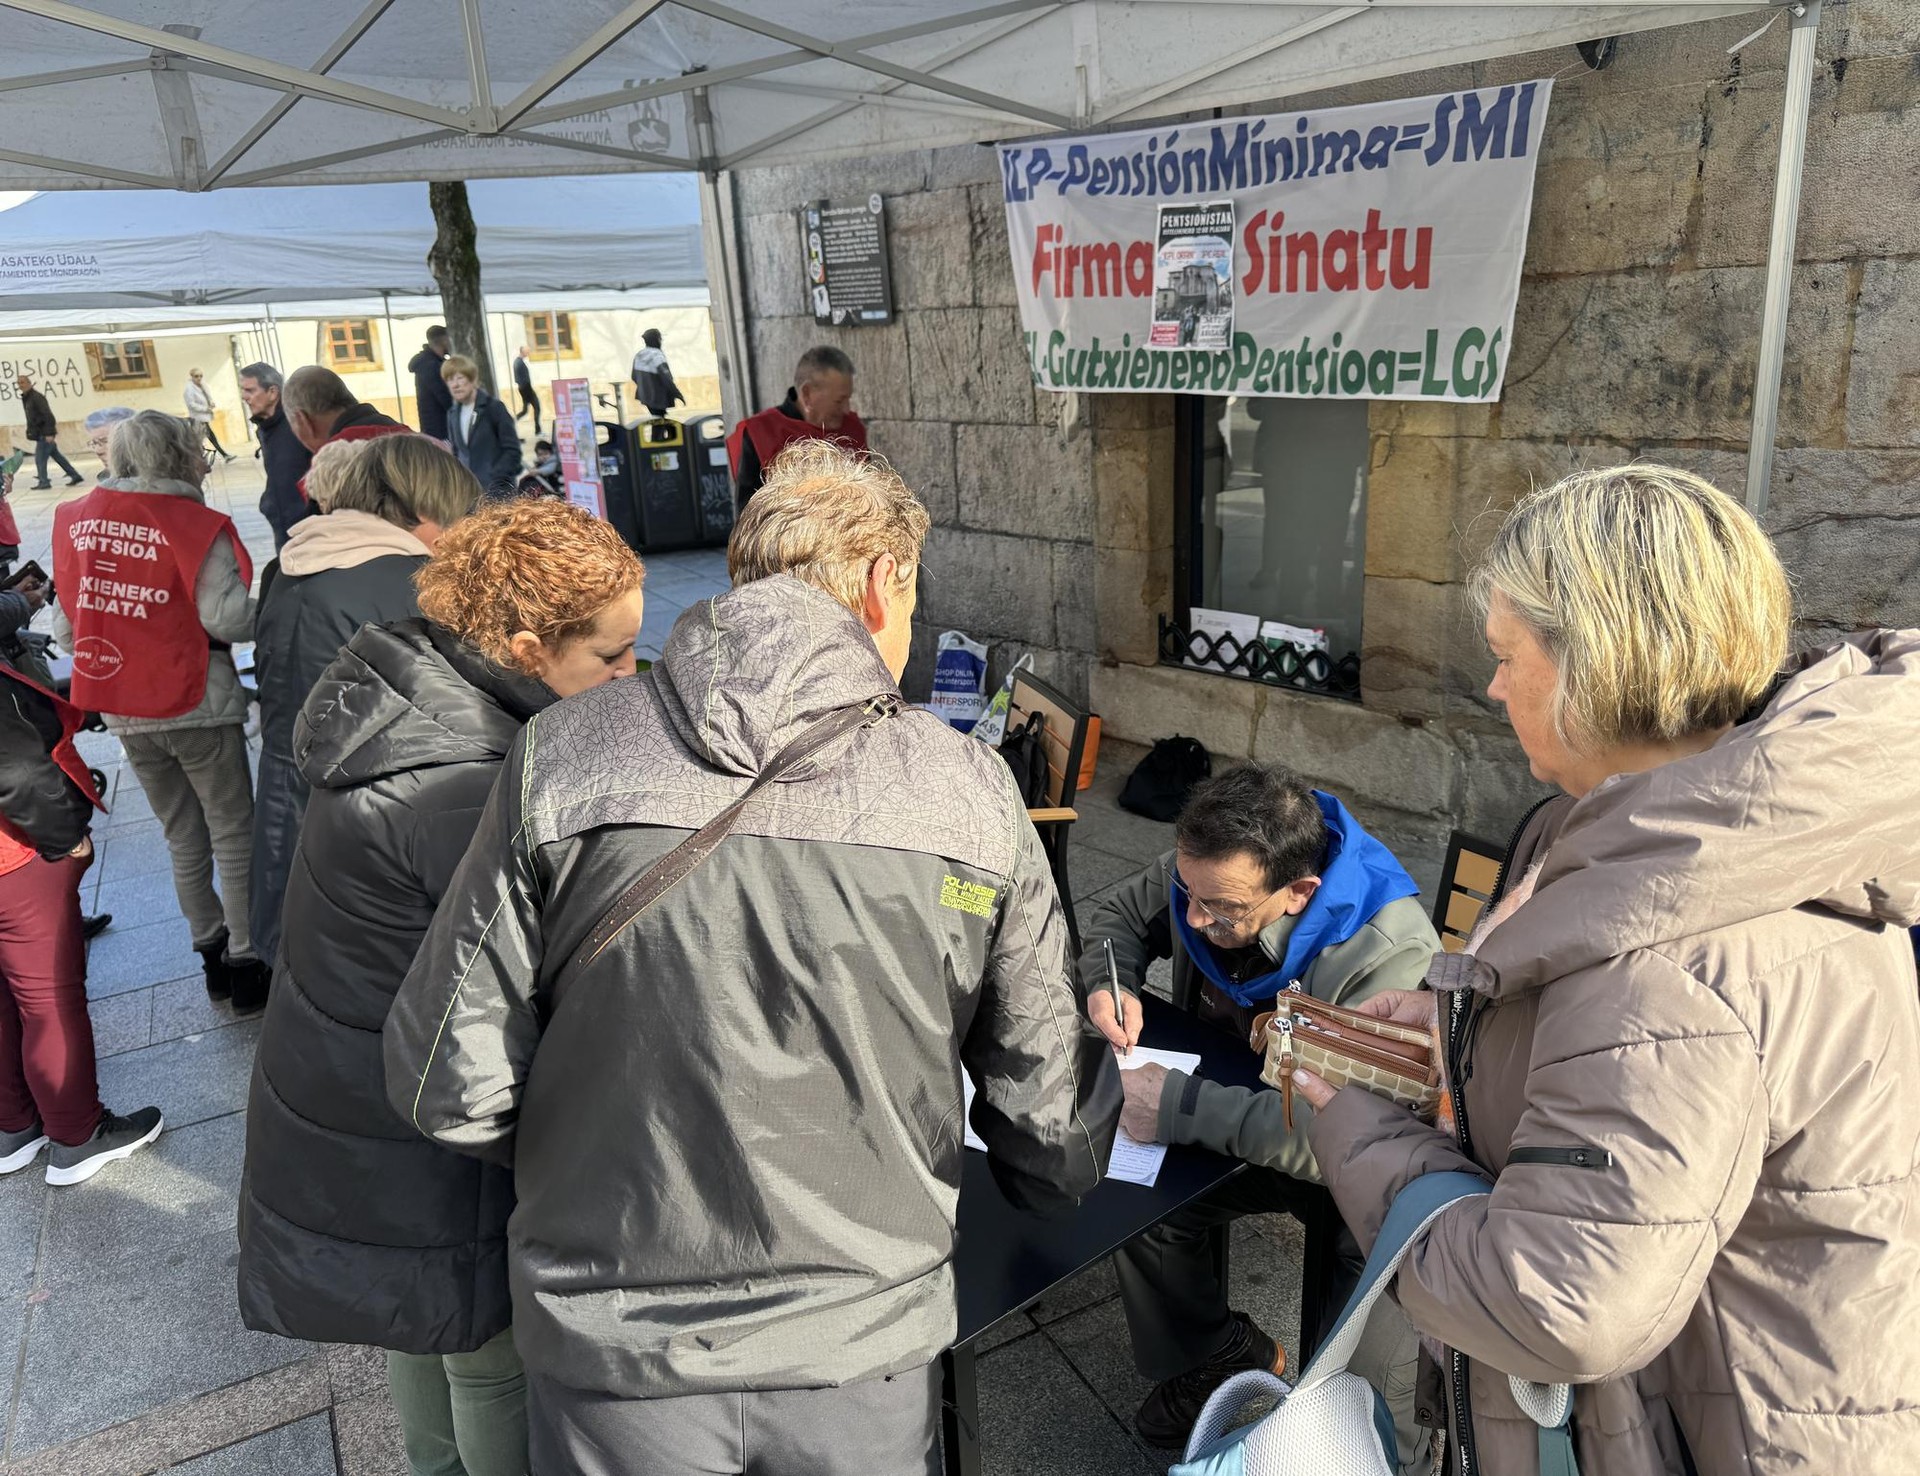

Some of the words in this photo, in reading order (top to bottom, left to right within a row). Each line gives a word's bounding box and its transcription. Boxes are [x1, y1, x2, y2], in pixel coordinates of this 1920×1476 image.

[0, 255, 55, 267] ASATEKO
[57, 253, 98, 266] UDALA
[1032, 223, 1154, 298] Firma
[1241, 208, 1433, 296] Sinatu
[0, 357, 80, 379] BISIOA
[0, 378, 84, 401] BEATU
[79, 575, 170, 604] XIENEKO
[76, 593, 148, 619] OLDATA
